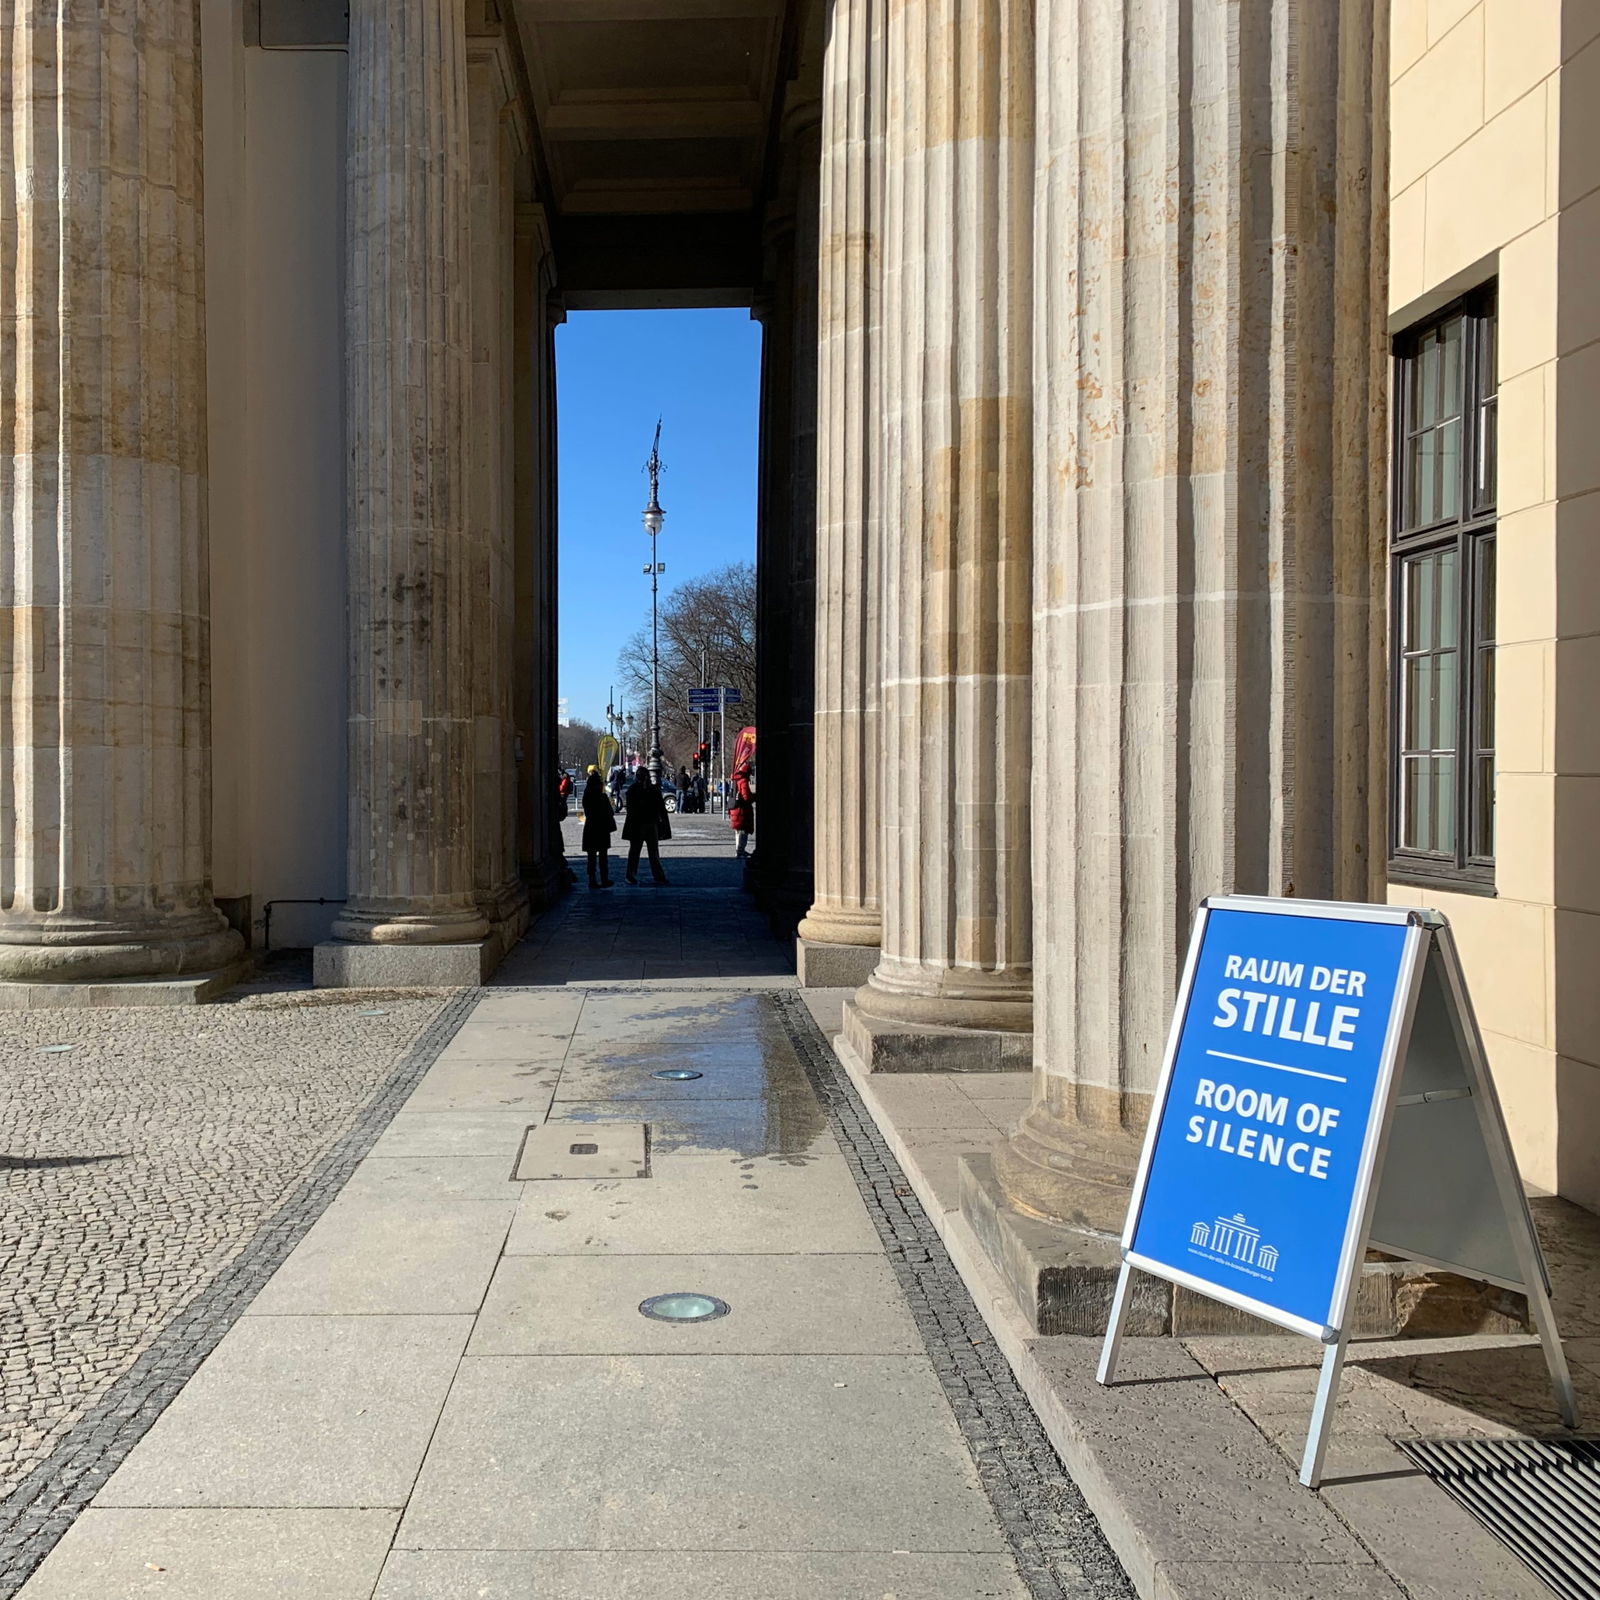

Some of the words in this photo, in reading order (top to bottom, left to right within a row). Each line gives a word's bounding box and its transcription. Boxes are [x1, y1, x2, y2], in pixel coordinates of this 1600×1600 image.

[1224, 954, 1305, 988] RAUM
[1309, 966, 1367, 997] DER
[1212, 988, 1360, 1051] STILLE
[1195, 1078, 1289, 1126] ROOM
[1296, 1102, 1340, 1137] OF
[1185, 1115, 1332, 1180] SILENCE
